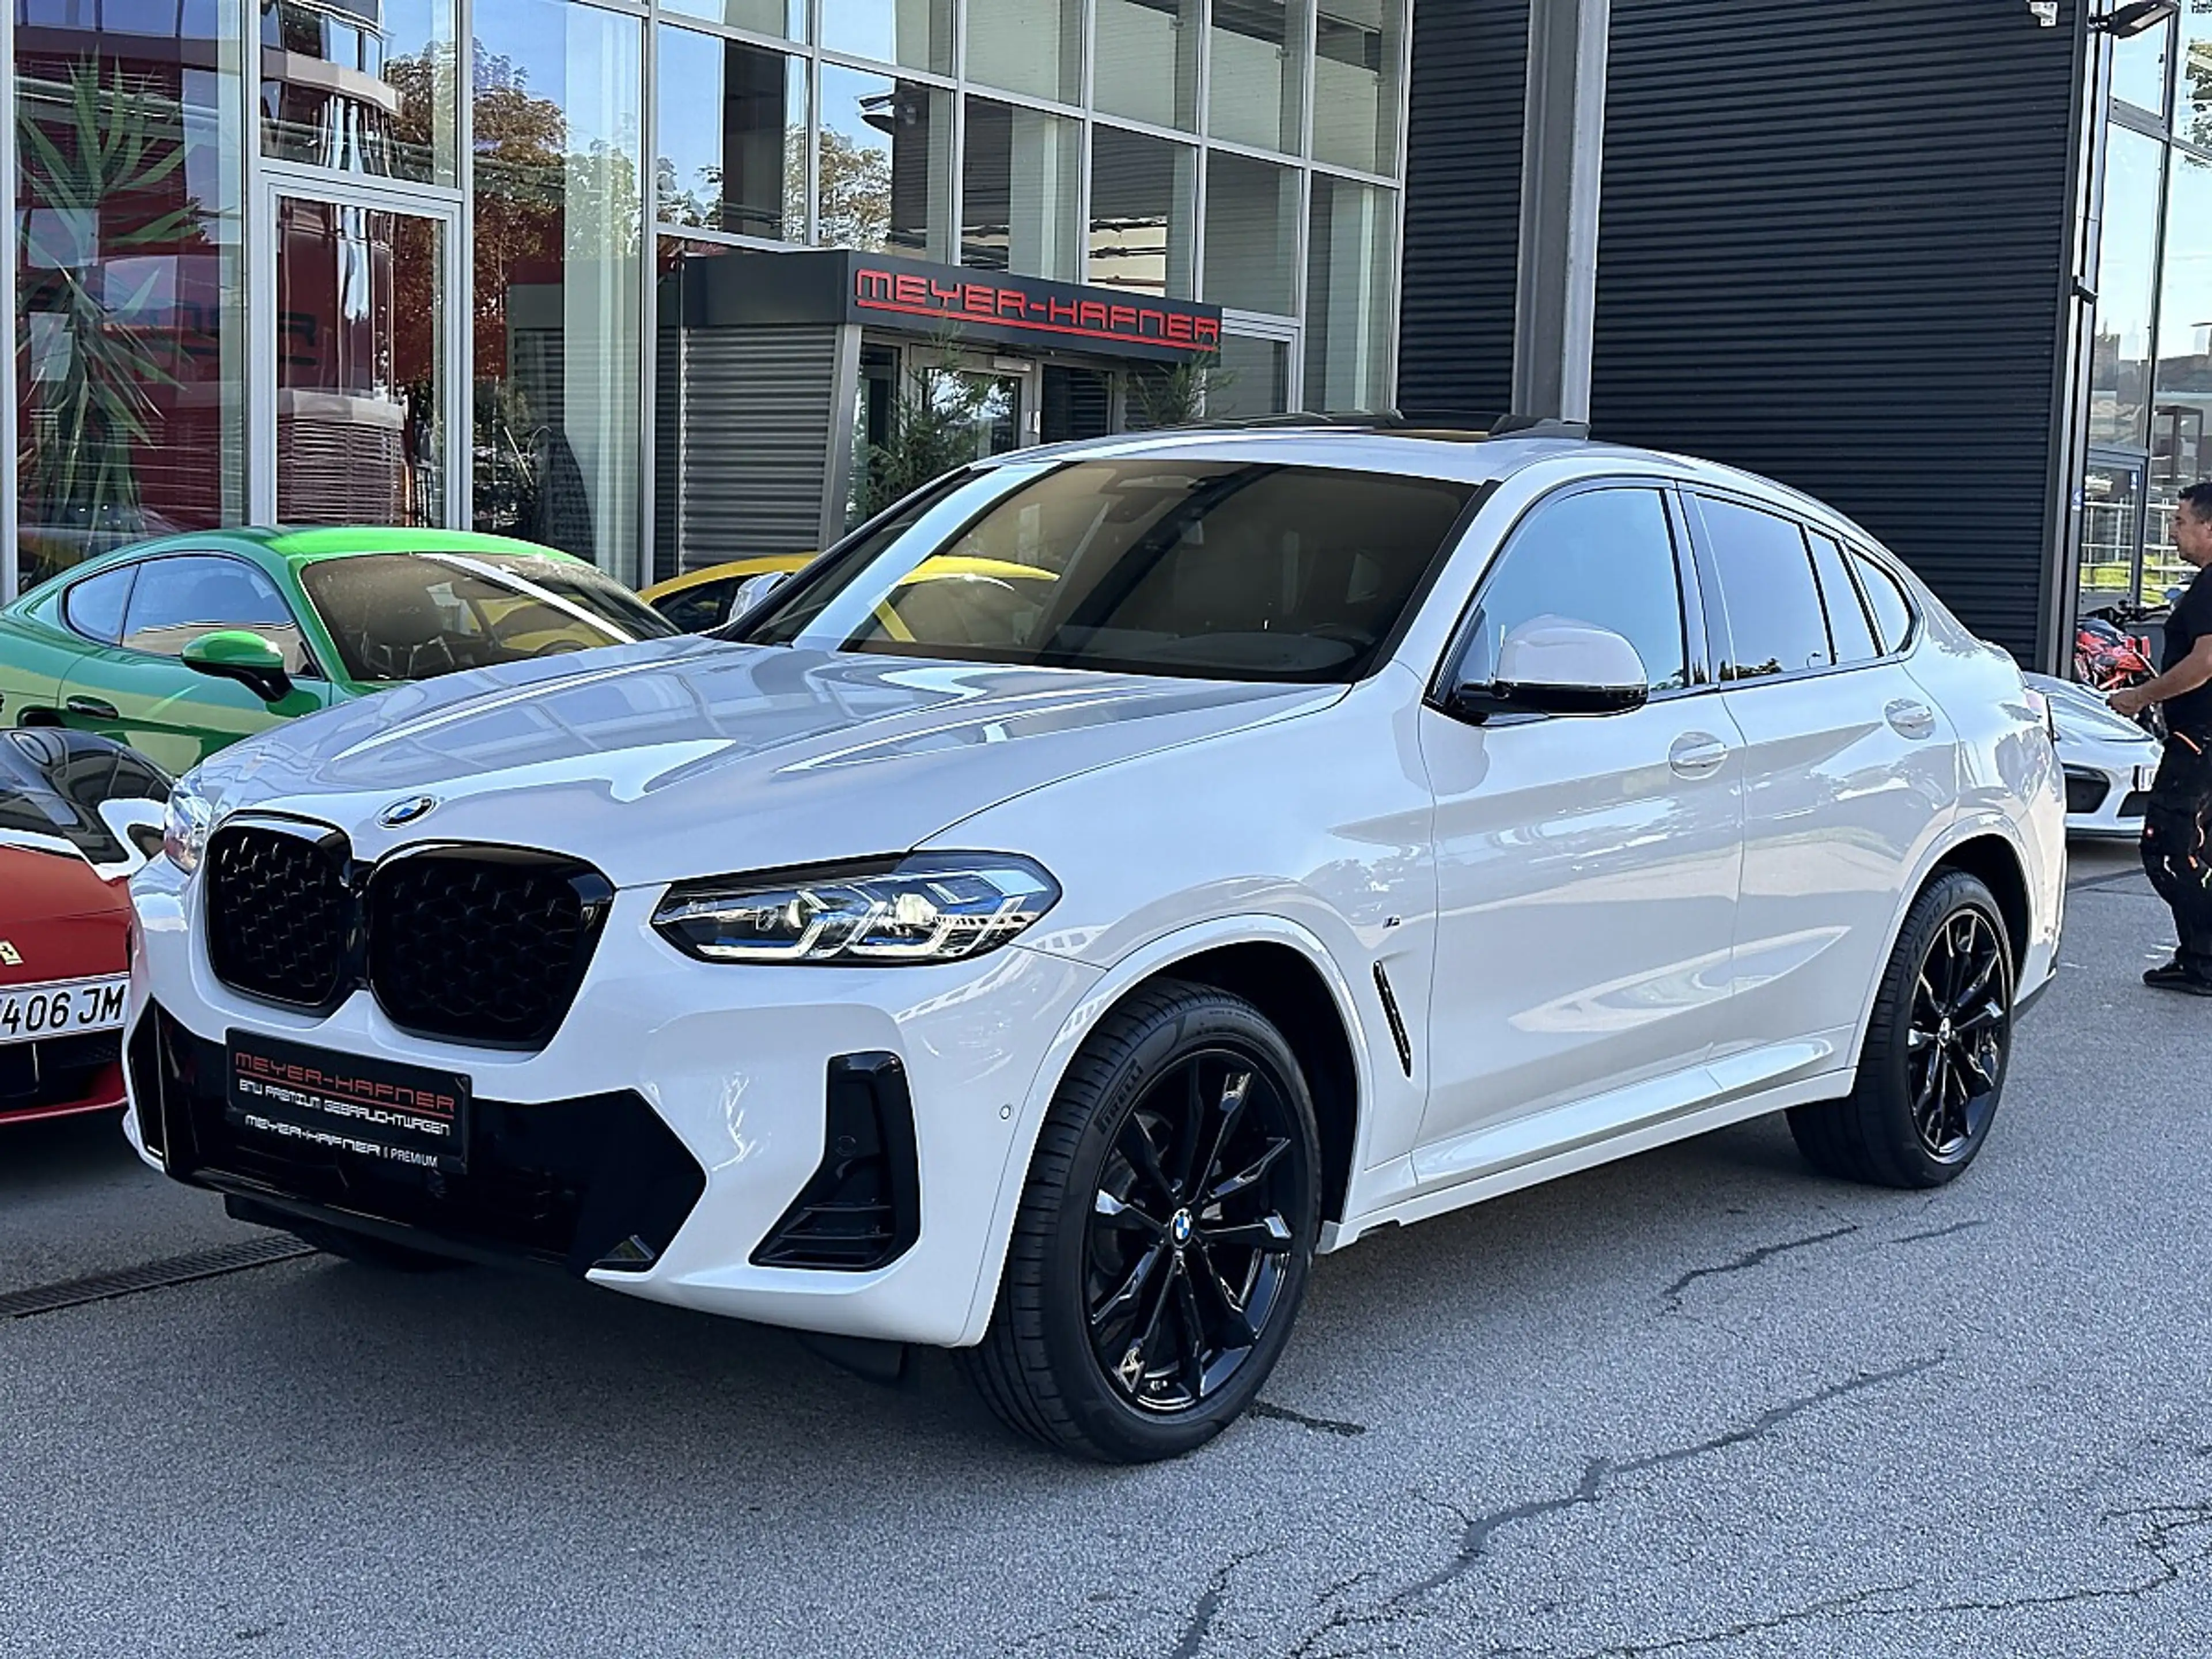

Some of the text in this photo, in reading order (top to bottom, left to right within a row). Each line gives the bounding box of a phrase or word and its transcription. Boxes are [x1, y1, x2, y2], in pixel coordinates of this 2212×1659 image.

[856, 269, 1220, 342] MEYER-HAFNER
[78, 984, 126, 1024] JM
[236, 1052, 454, 1112] MEYER-HAFNER
[245, 1114, 380, 1157] MEYER-HAFNER
[391, 1147, 438, 1168] PREMIUM
